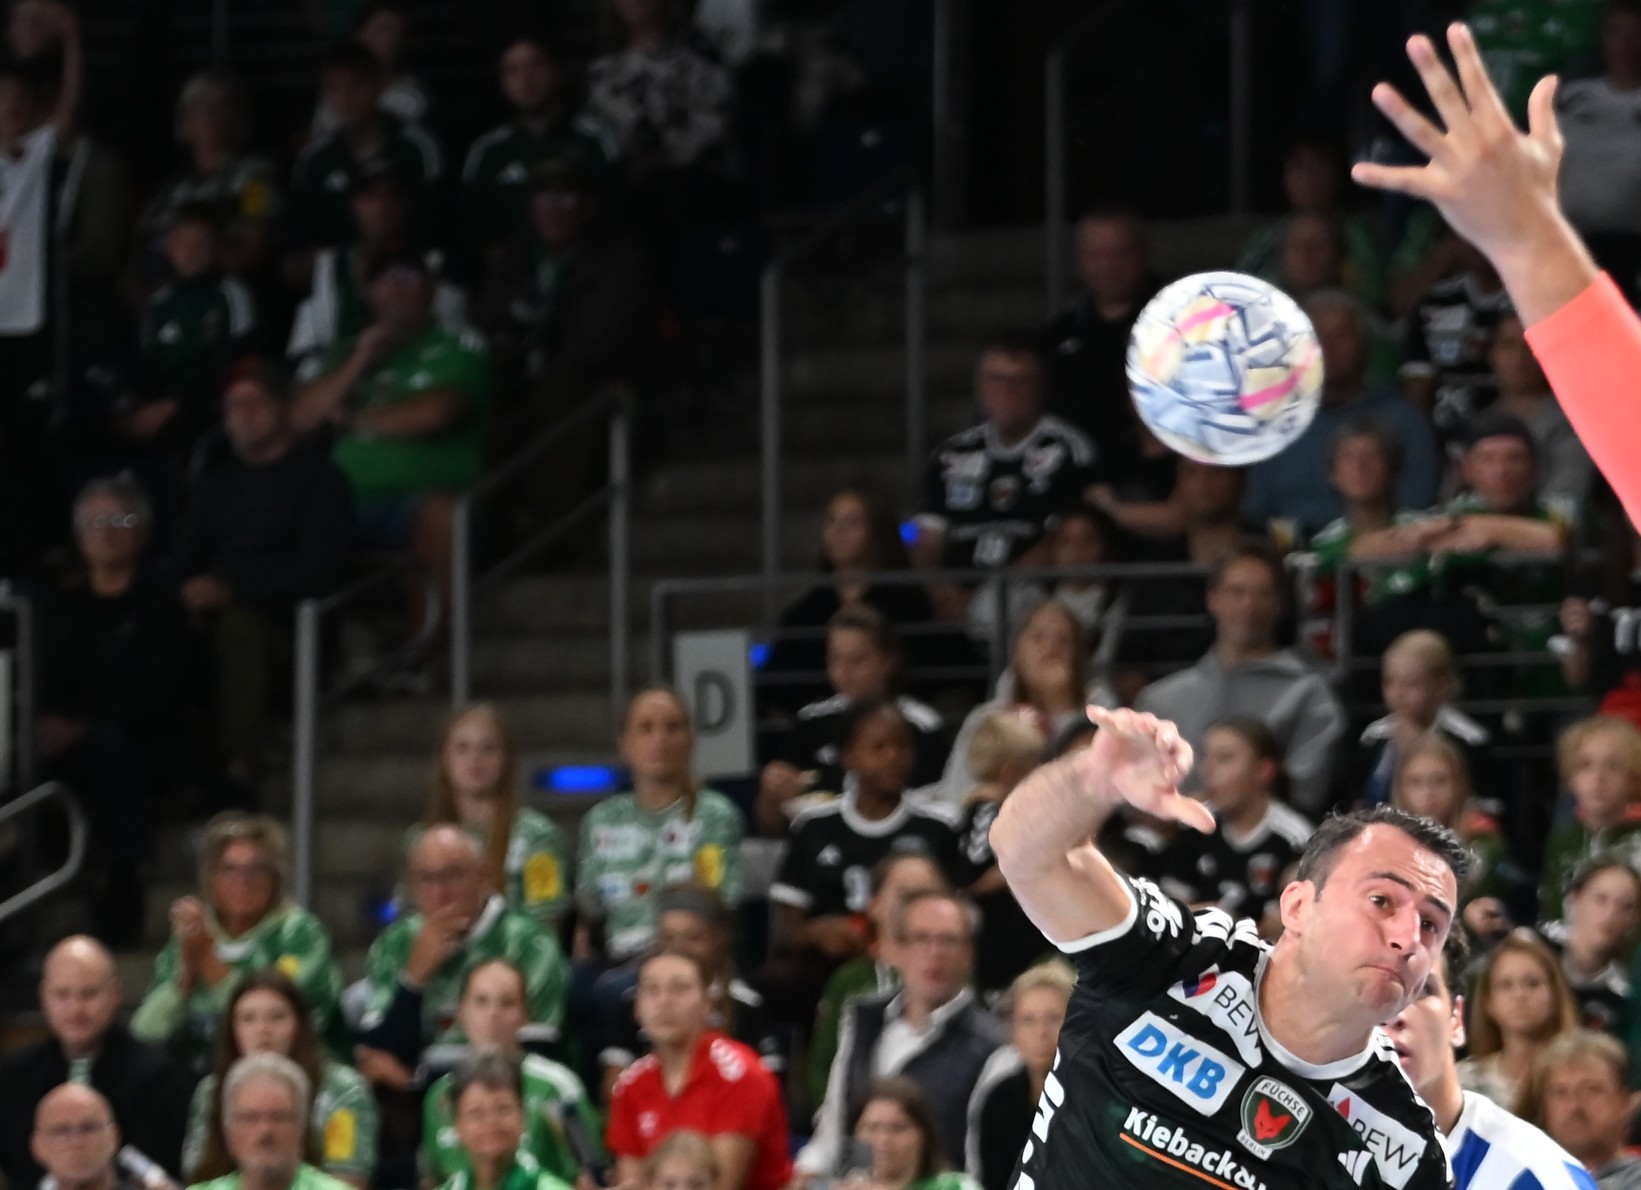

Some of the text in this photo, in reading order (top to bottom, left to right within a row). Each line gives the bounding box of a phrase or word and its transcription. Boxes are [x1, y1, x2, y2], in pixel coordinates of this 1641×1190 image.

[693, 668, 736, 736] D
[1127, 1022, 1226, 1100] DKB
[1260, 1081, 1307, 1118] FÜCHSE
[1123, 1106, 1267, 1190] Kieback&
[1238, 1134, 1267, 1157] BERLIN
